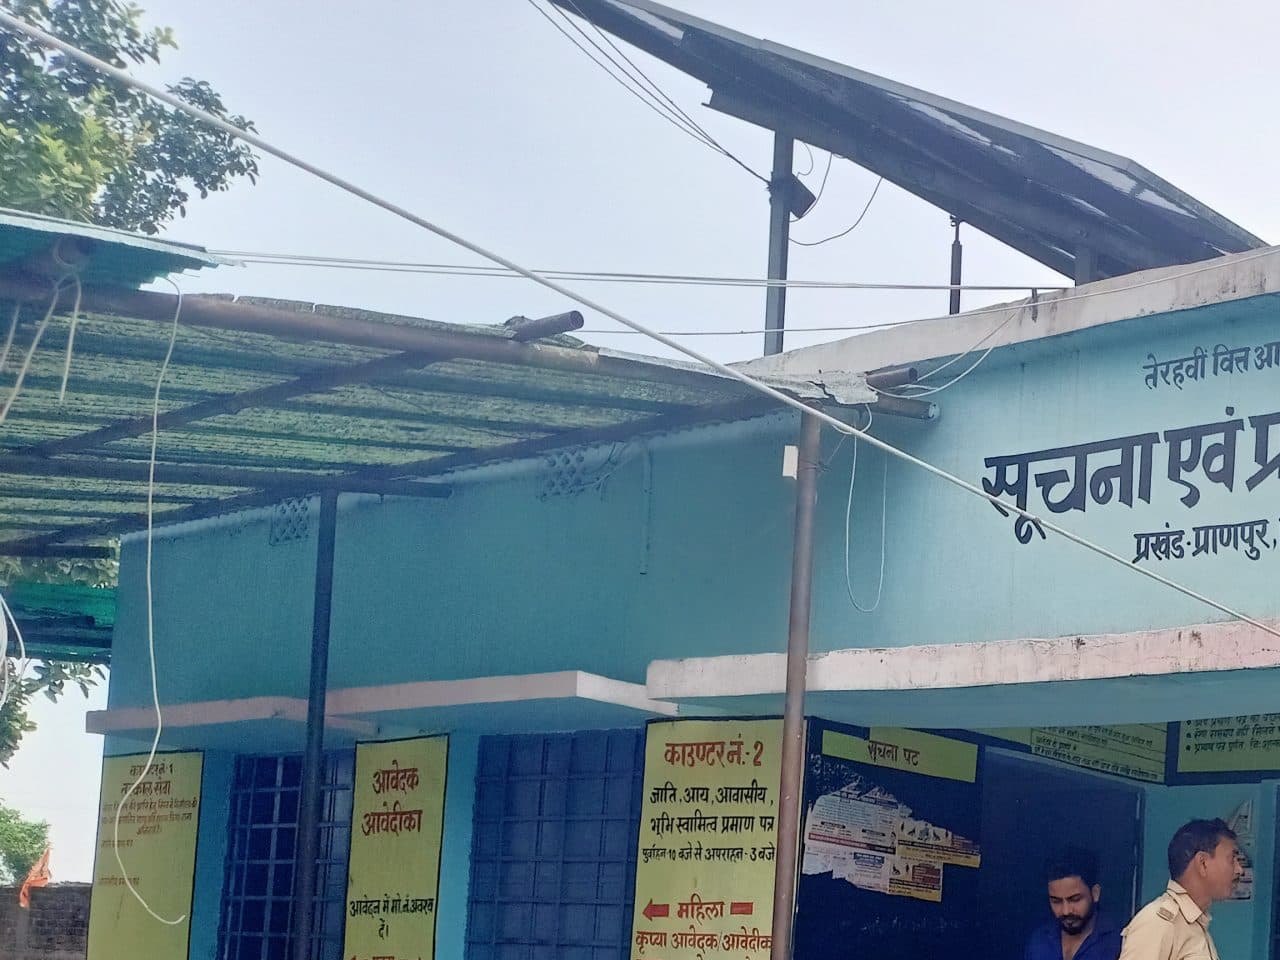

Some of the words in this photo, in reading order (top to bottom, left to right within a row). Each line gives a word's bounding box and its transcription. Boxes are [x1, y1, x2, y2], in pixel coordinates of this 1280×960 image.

[1143, 347, 1208, 390] तेरहवीं
[982, 431, 1160, 545] सूचना
[1163, 406, 1245, 509] एवं
[372, 759, 419, 795] आवेदक
[721, 815, 756, 834] प्रमाण
[759, 815, 776, 832] पत्र
[677, 893, 725, 926] महिला
